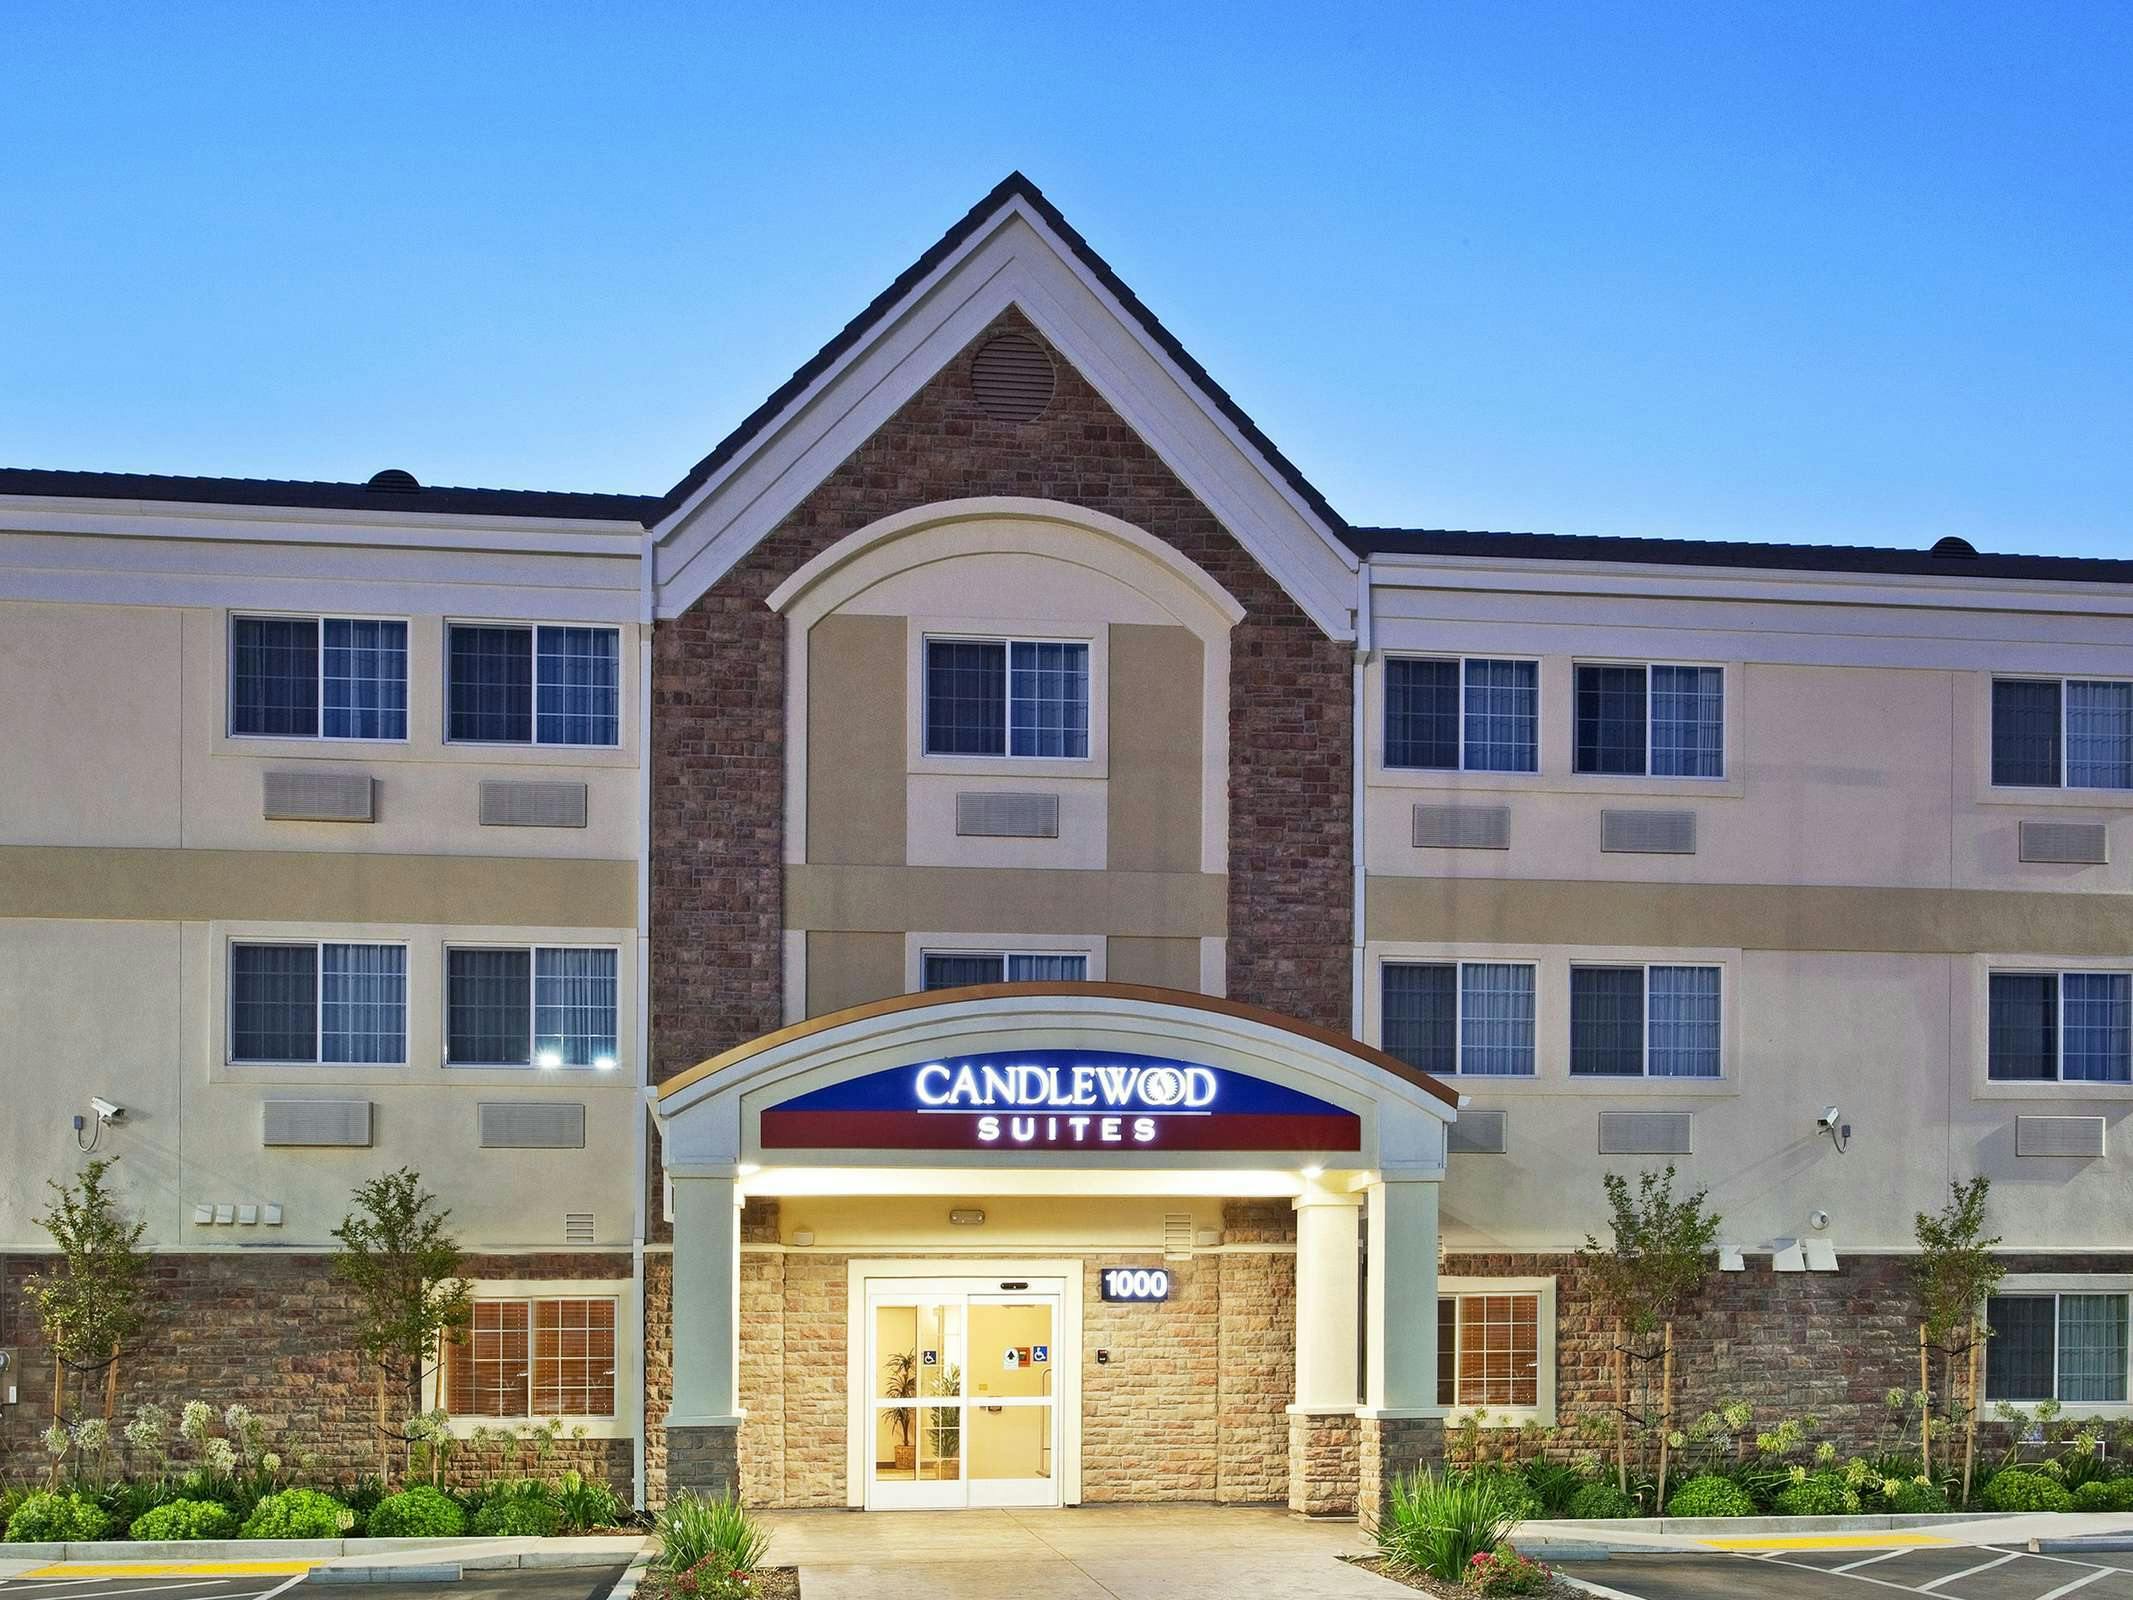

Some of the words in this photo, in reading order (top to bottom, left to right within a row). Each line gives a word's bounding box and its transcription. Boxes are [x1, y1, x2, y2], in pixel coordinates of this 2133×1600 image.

[916, 1065, 1216, 1106] CANDLEWOOD
[978, 1117, 1156, 1142] SUITES
[1105, 1270, 1168, 1297] 1000
